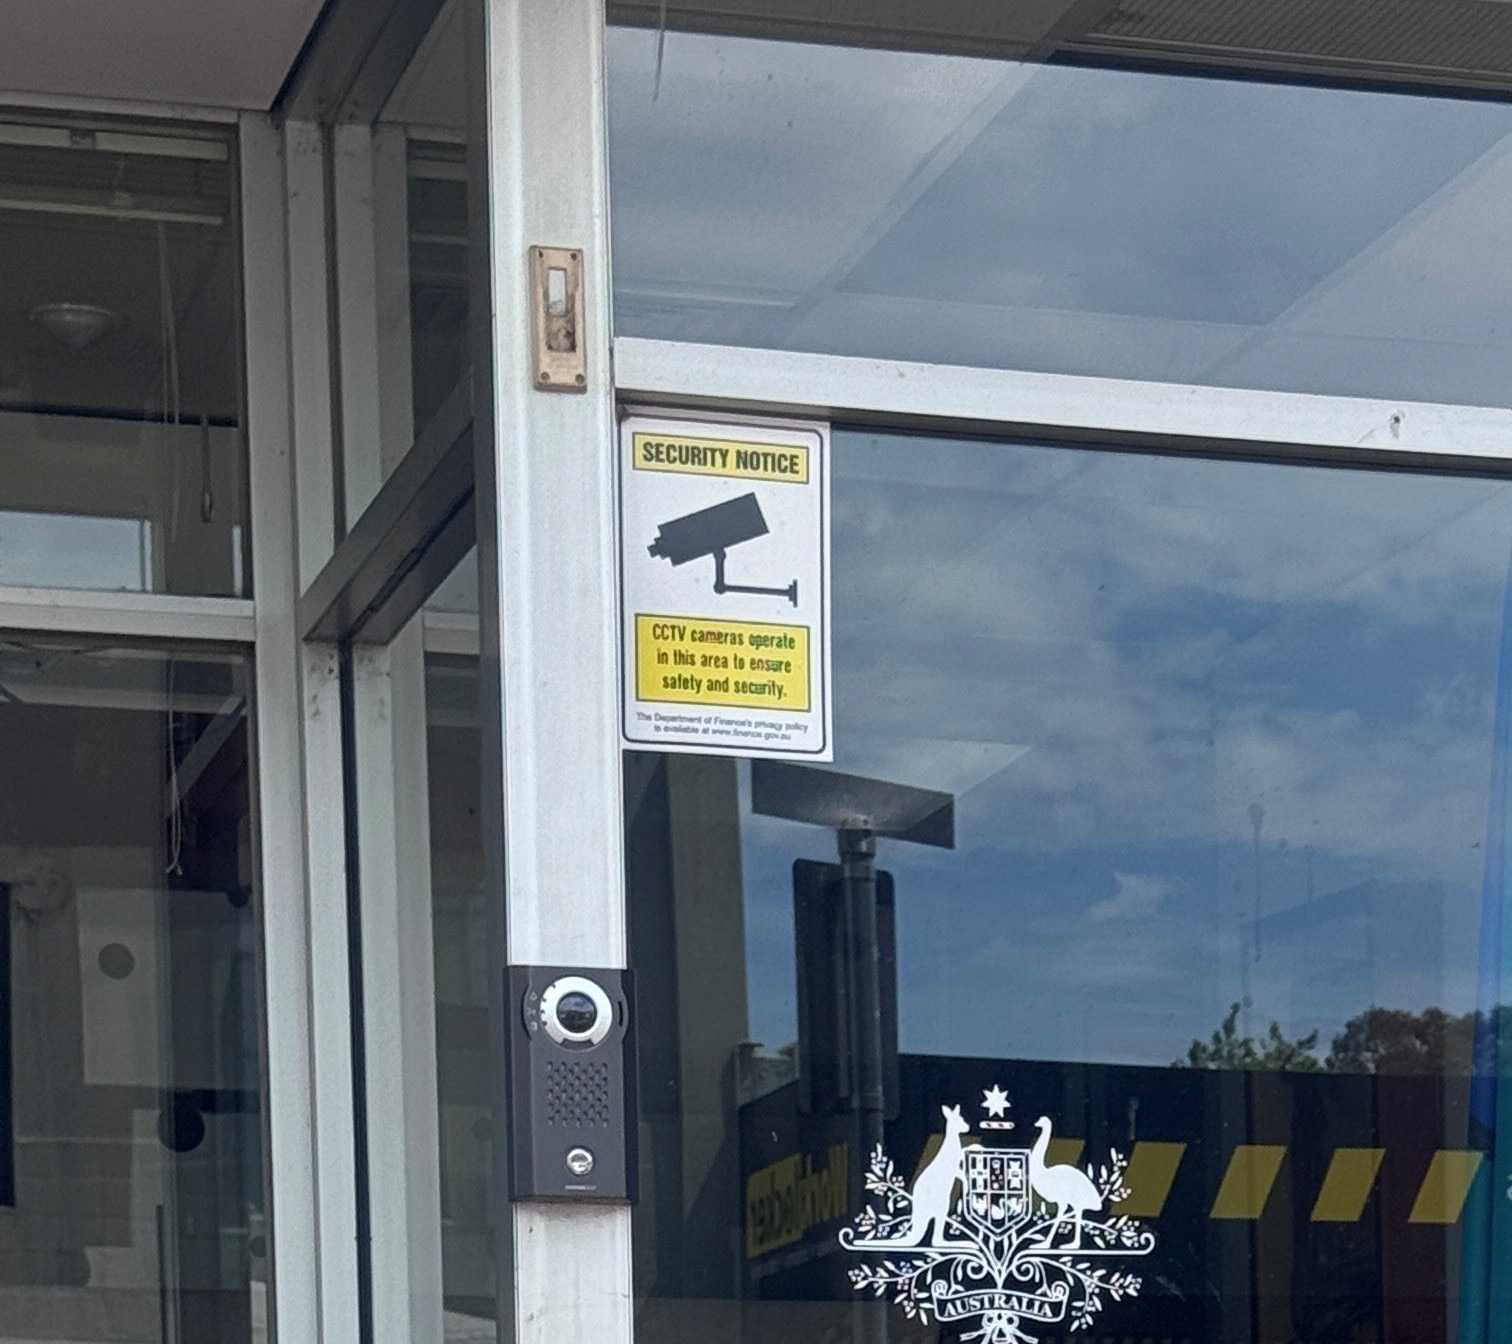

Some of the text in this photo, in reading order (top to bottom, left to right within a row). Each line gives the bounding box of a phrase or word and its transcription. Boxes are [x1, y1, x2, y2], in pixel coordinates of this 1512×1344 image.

[643, 442, 800, 475] SECURITY NOTICE
[652, 623, 795, 650] CCTV cameras operate
[657, 648, 791, 673] in this area to ensure
[662, 673, 787, 700] safety and security.
[944, 1293, 1053, 1318] AUSTRALIA
